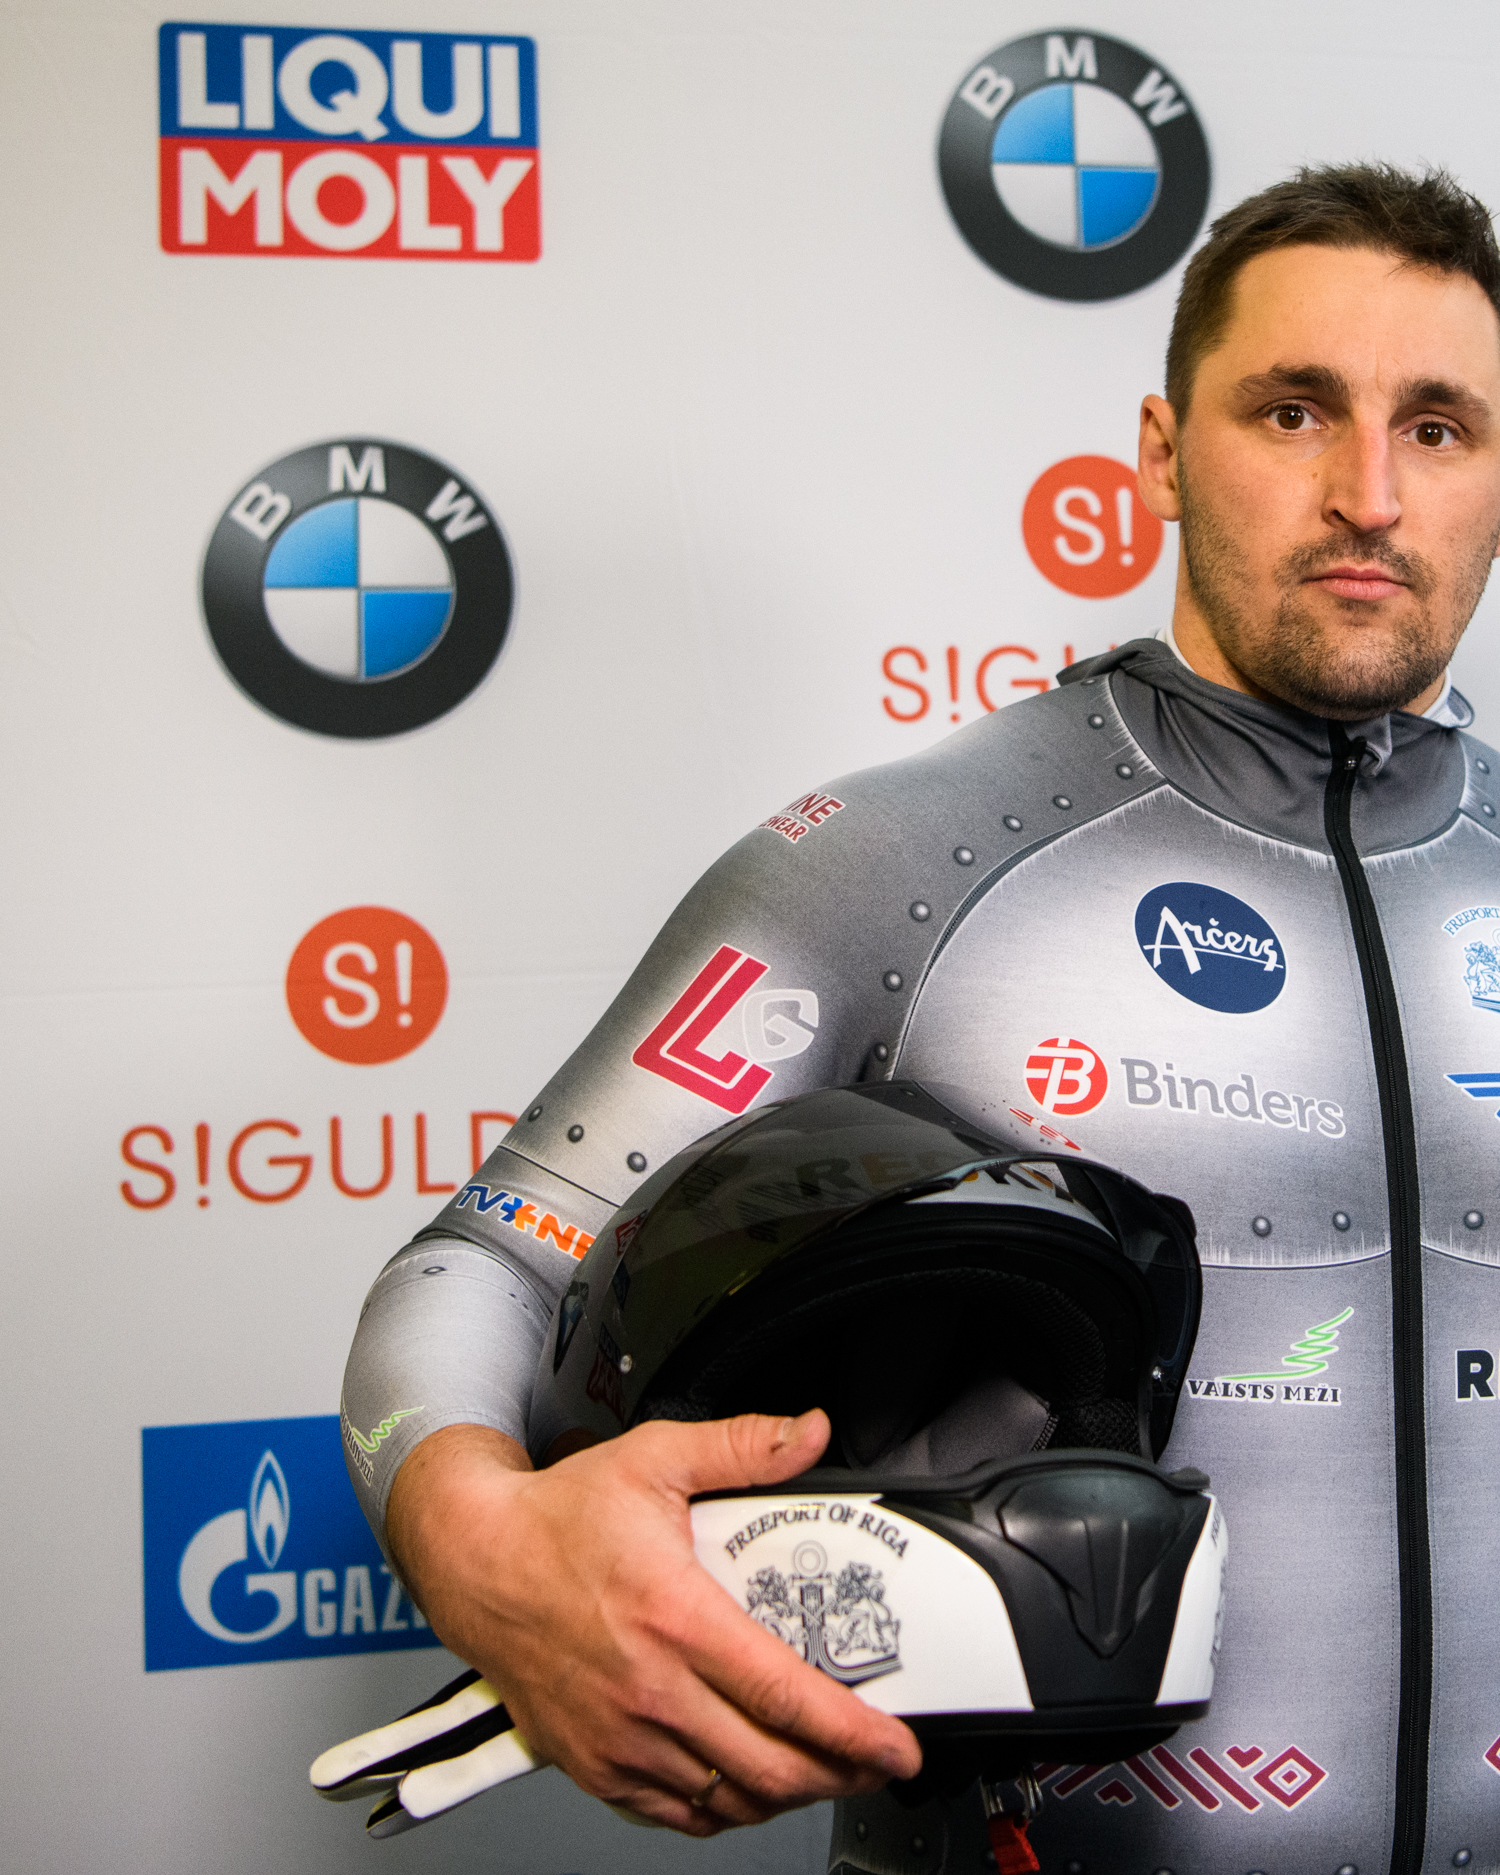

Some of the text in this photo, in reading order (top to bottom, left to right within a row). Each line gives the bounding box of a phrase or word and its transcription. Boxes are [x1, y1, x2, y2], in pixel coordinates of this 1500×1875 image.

[177, 31, 522, 142] LIQUI
[960, 36, 1187, 129] BMW
[178, 147, 535, 253] MOLY
[231, 446, 487, 543] BMW
[1443, 906, 1500, 936] FREEPORT
[1120, 1057, 1347, 1138] Binders
[1187, 1379, 1276, 1400] VALSTS
[1283, 1382, 1340, 1403] MEŽI
[724, 1502, 910, 1560] FREEPORT OF RIGA
